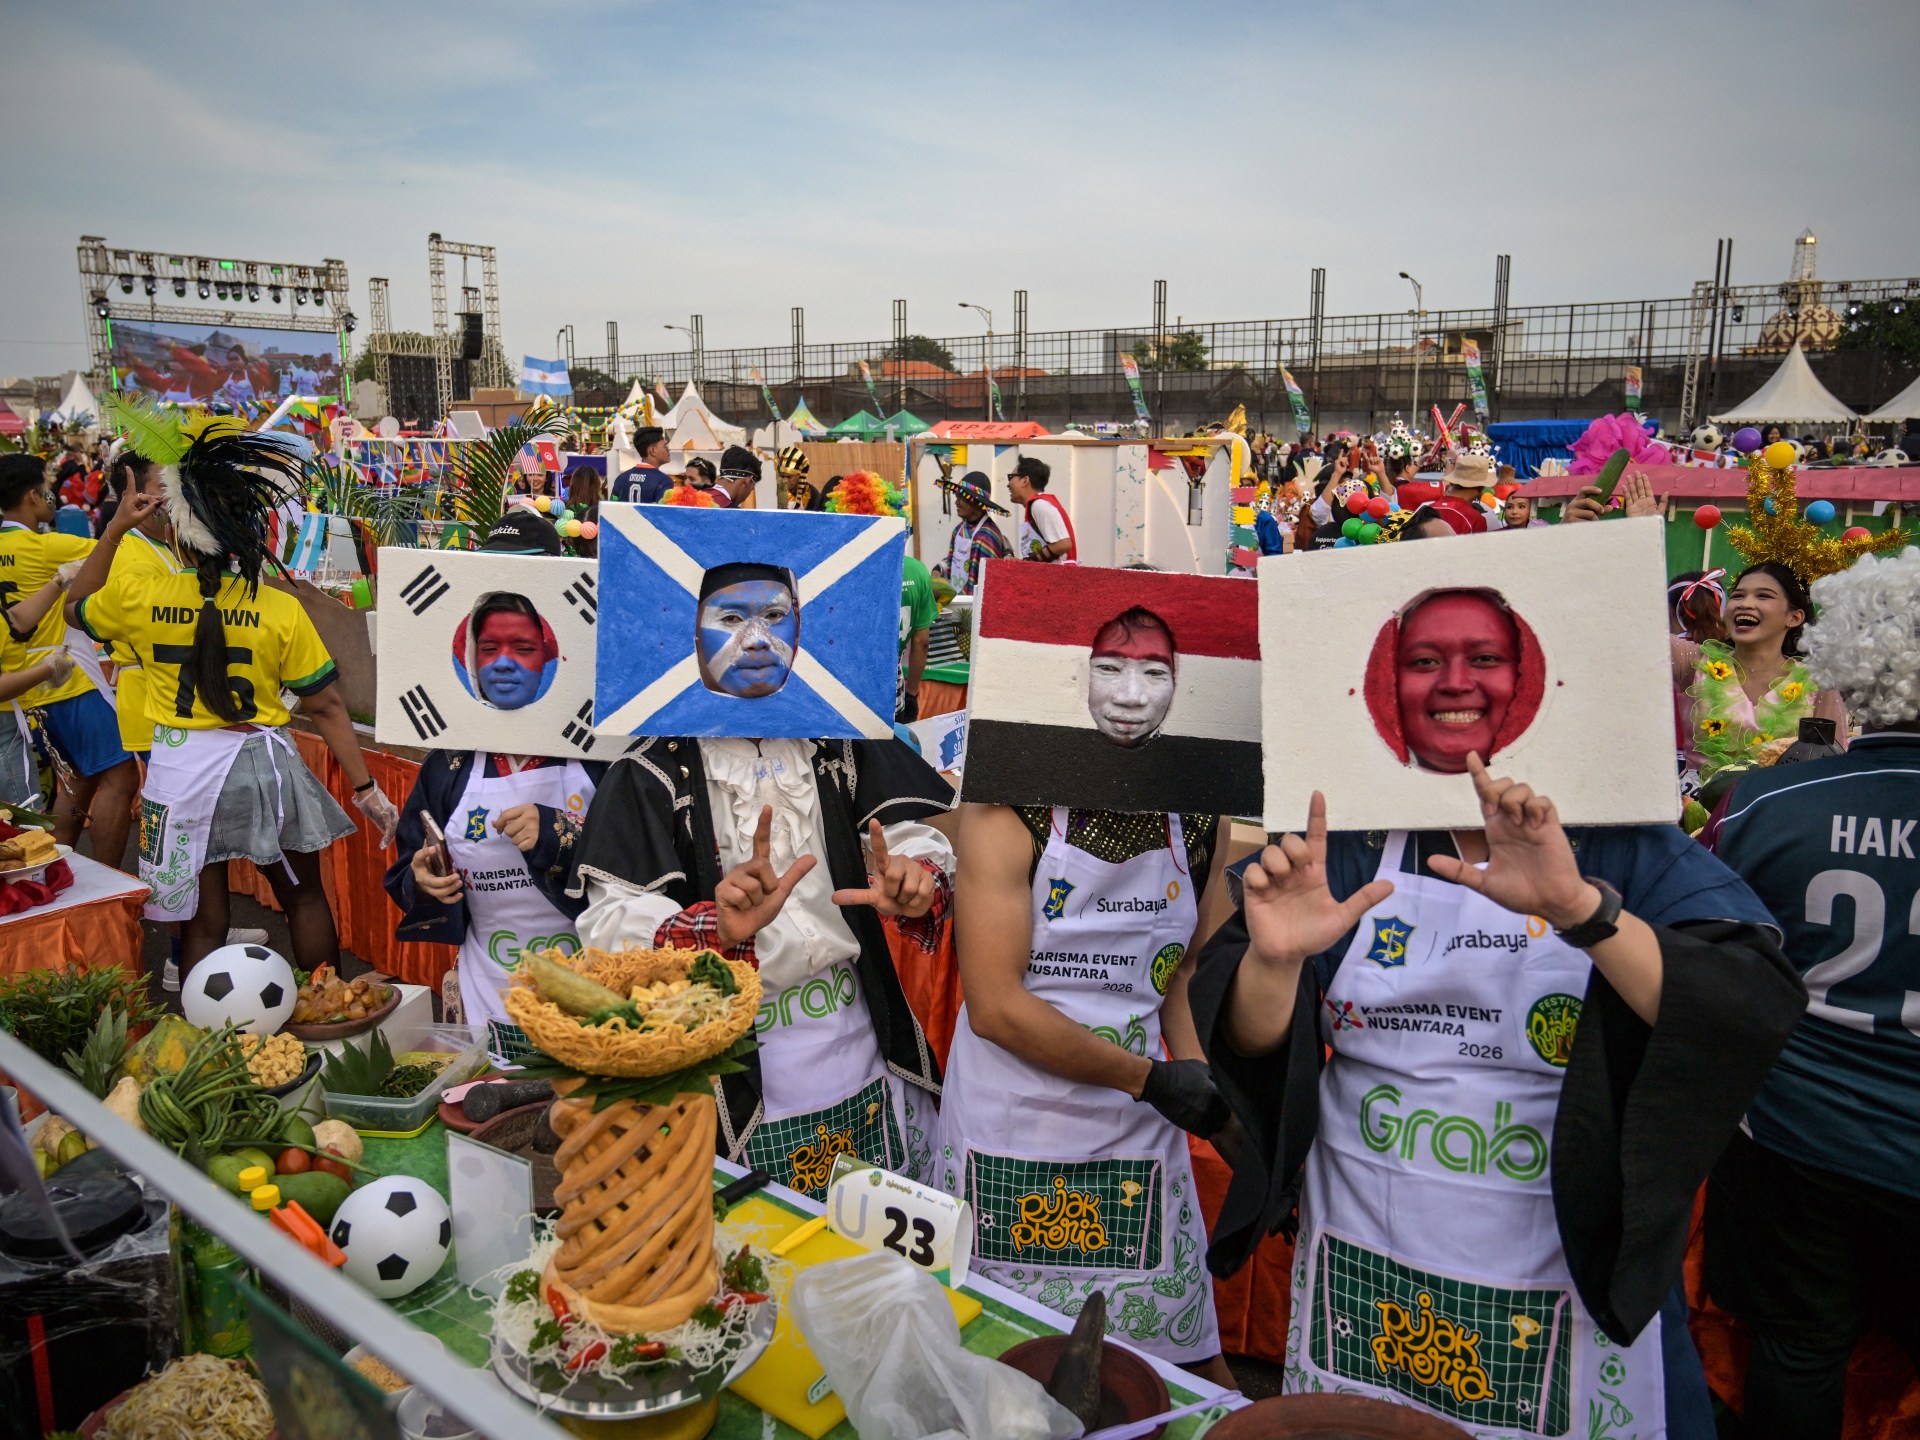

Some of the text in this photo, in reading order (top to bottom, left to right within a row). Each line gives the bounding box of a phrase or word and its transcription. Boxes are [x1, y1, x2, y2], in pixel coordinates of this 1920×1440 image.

[472, 867, 525, 881] KARISMA
[475, 878, 536, 892] NUSANTAR
[1096, 897, 1168, 916] Surabaya
[1442, 929, 1528, 957] urabaya
[1092, 954, 1138, 967] EVENT
[1101, 982, 1133, 993] 2026
[1446, 1004, 1503, 1023] EVENT
[1366, 1016, 1465, 1037] NUSANTARA
[1458, 1042, 1503, 1060] 2026
[1359, 1083, 1549, 1182] Grab
[835, 1183, 936, 1267] U 23
